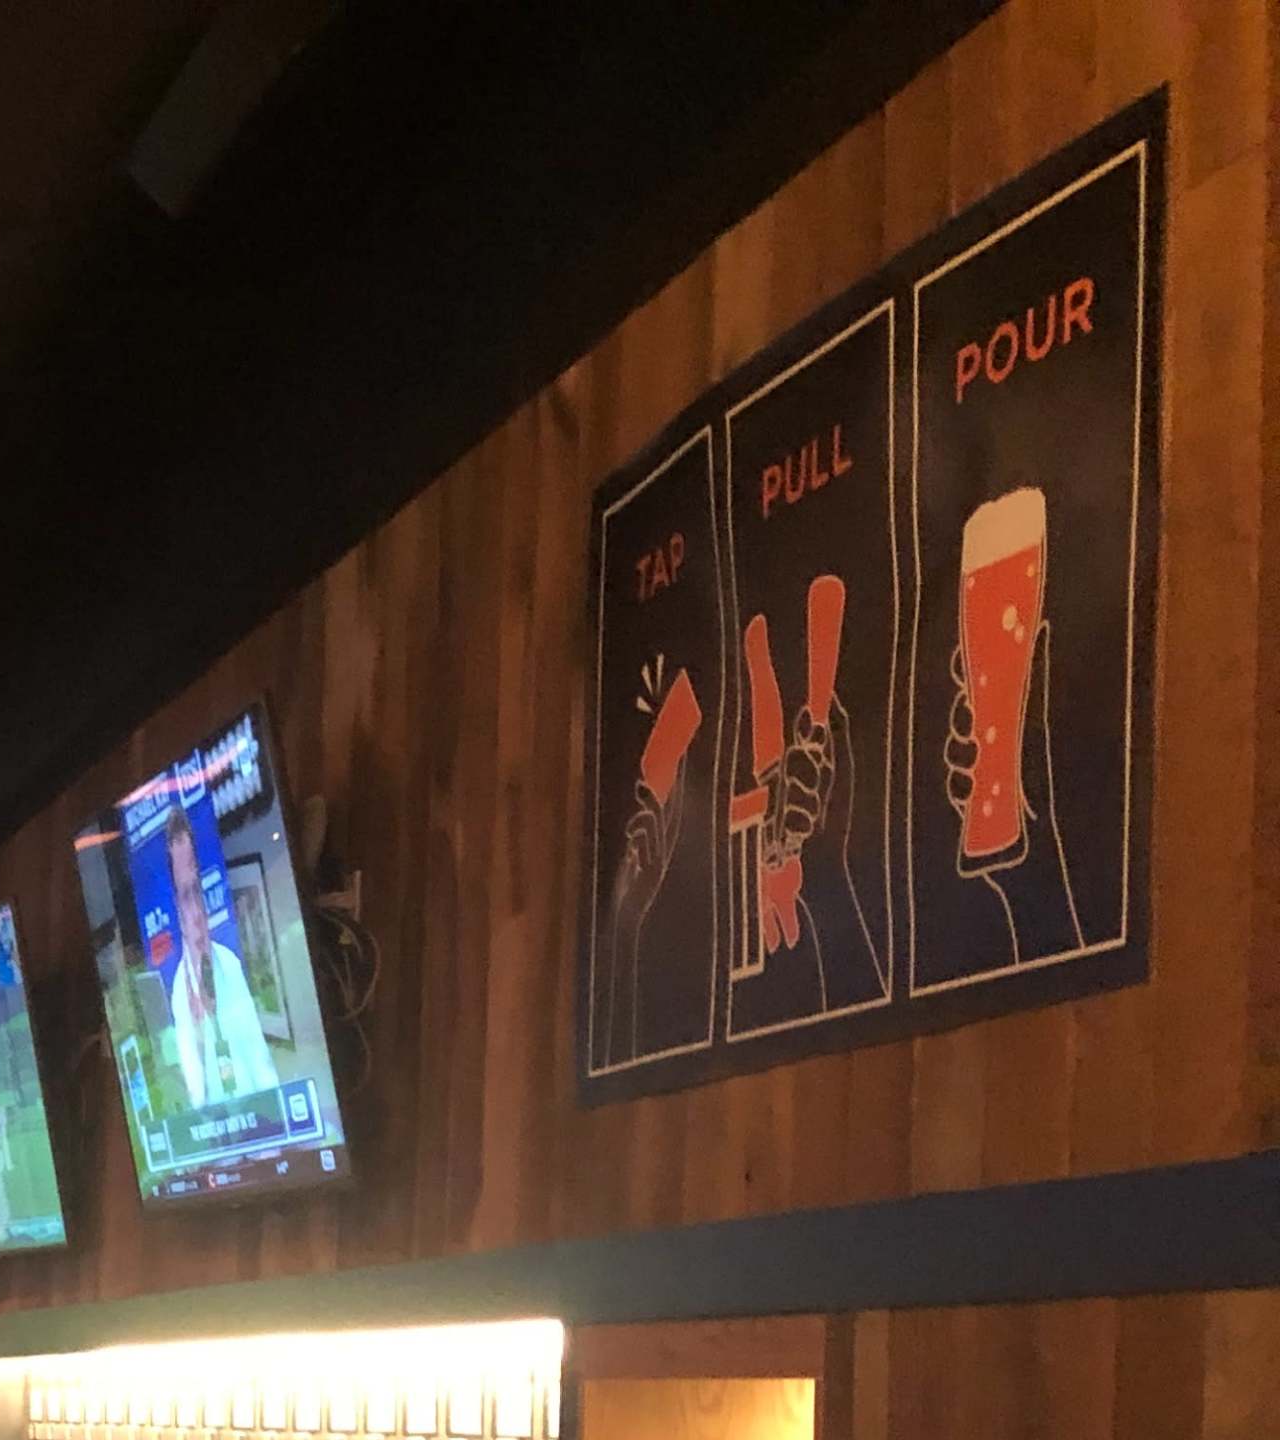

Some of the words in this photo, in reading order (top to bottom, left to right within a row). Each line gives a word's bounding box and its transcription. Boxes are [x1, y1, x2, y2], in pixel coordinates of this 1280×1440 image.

[955, 276, 1096, 403] POUR
[760, 424, 853, 519] PULL
[635, 530, 686, 601] TAP
